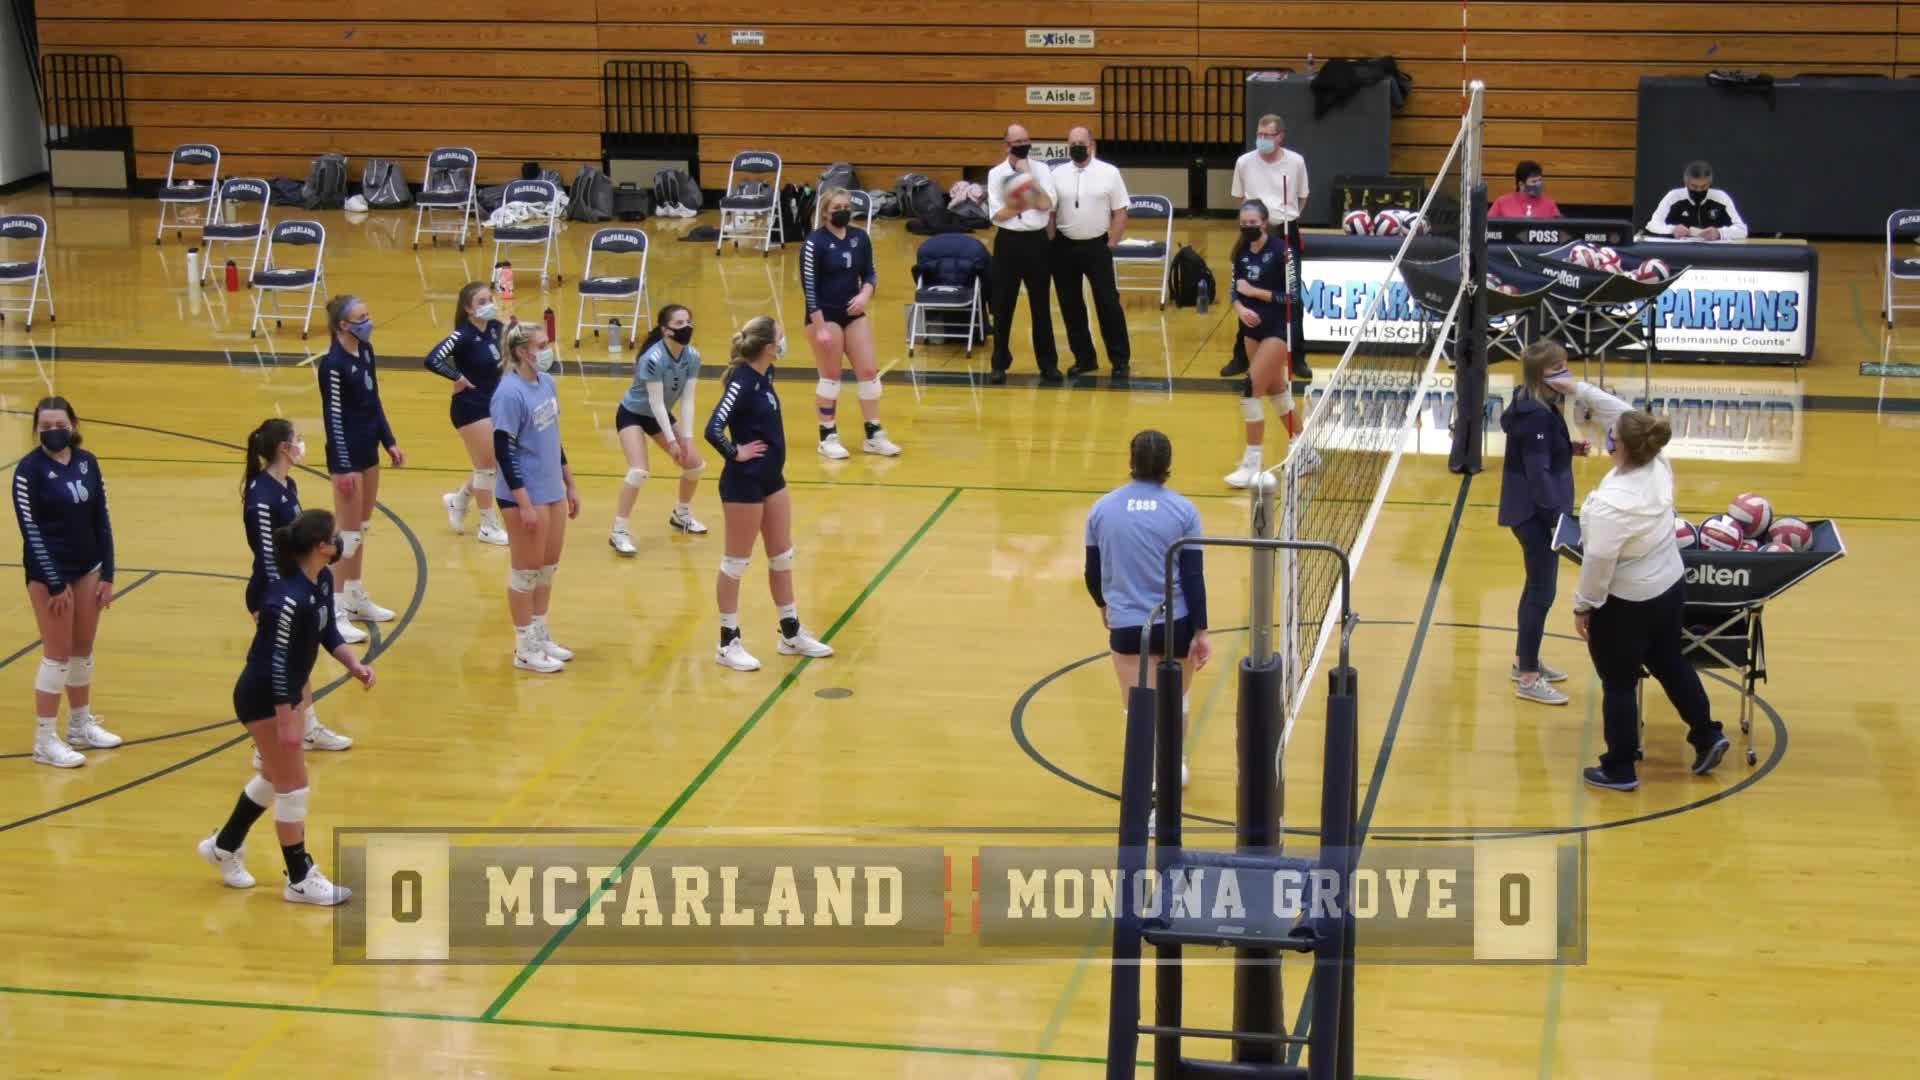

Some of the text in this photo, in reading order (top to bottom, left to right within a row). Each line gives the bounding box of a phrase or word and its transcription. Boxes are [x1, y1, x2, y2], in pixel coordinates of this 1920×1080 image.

[1045, 89, 1075, 101] Aisle
[437, 151, 470, 162] McFARLAND
[1045, 147, 1070, 159] Aisl
[228, 184, 262, 195] McFARLAND
[514, 185, 549, 197] McFARLAND
[2, 219, 38, 231] McFARLAND
[281, 225, 317, 238] McFARLAND
[1528, 230, 1559, 243] POSS
[1584, 233, 1607, 242] BONUS
[600, 233, 639, 246] McFARLAND
[1542, 266, 1580, 289] molten
[1640, 288, 1799, 332] PARTANS
[1655, 335, 1738, 347] portsmanship
[66, 479, 89, 503] 16
[1684, 563, 1750, 587] olten
